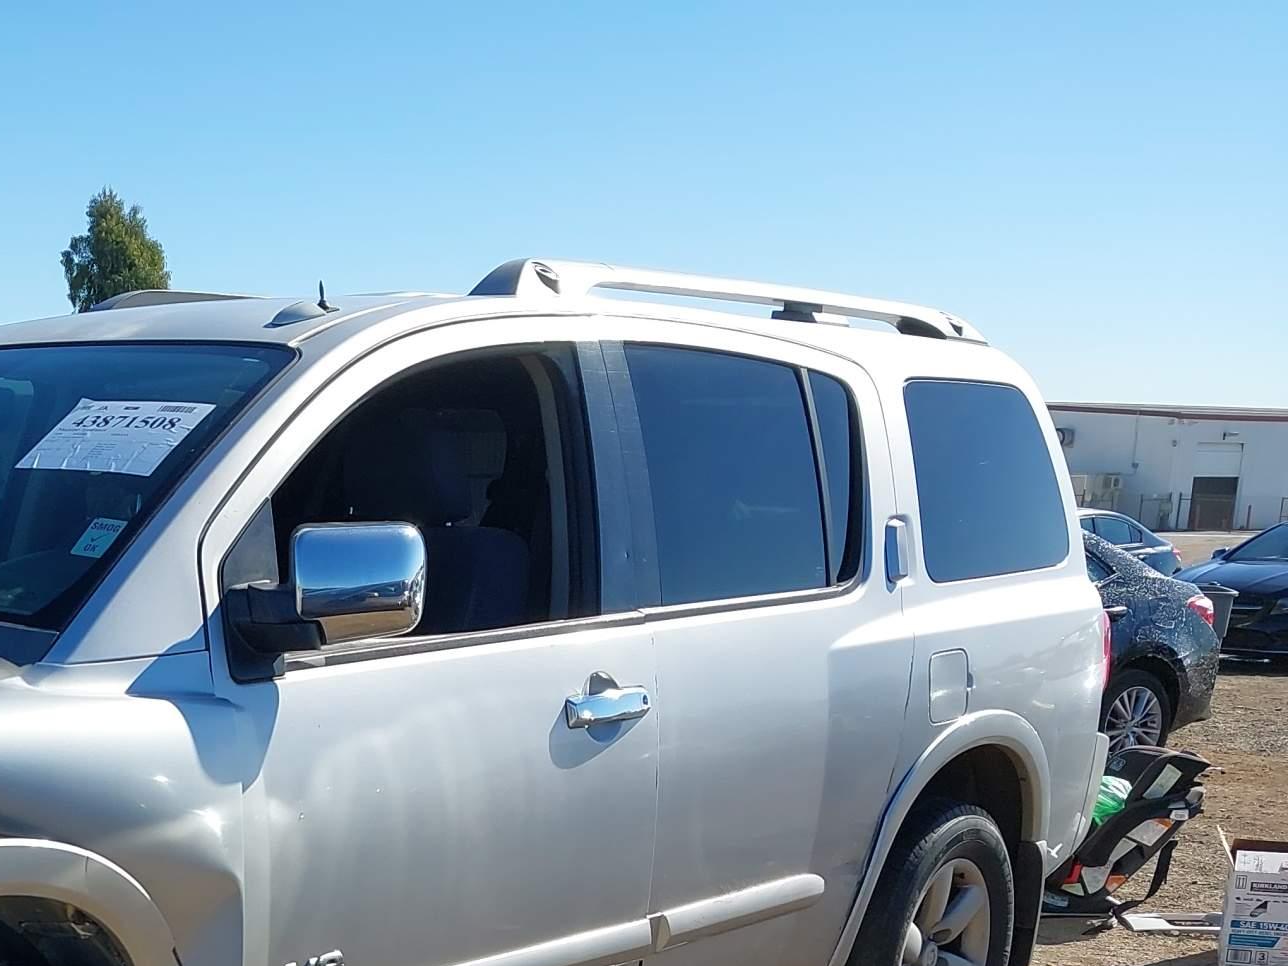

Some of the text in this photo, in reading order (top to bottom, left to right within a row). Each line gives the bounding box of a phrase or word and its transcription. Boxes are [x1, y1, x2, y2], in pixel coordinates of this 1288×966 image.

[72, 415, 182, 430] 43871508
[91, 522, 121, 532] SMOG
[83, 544, 99, 552] OK
[1239, 920, 1257, 928] SAE
